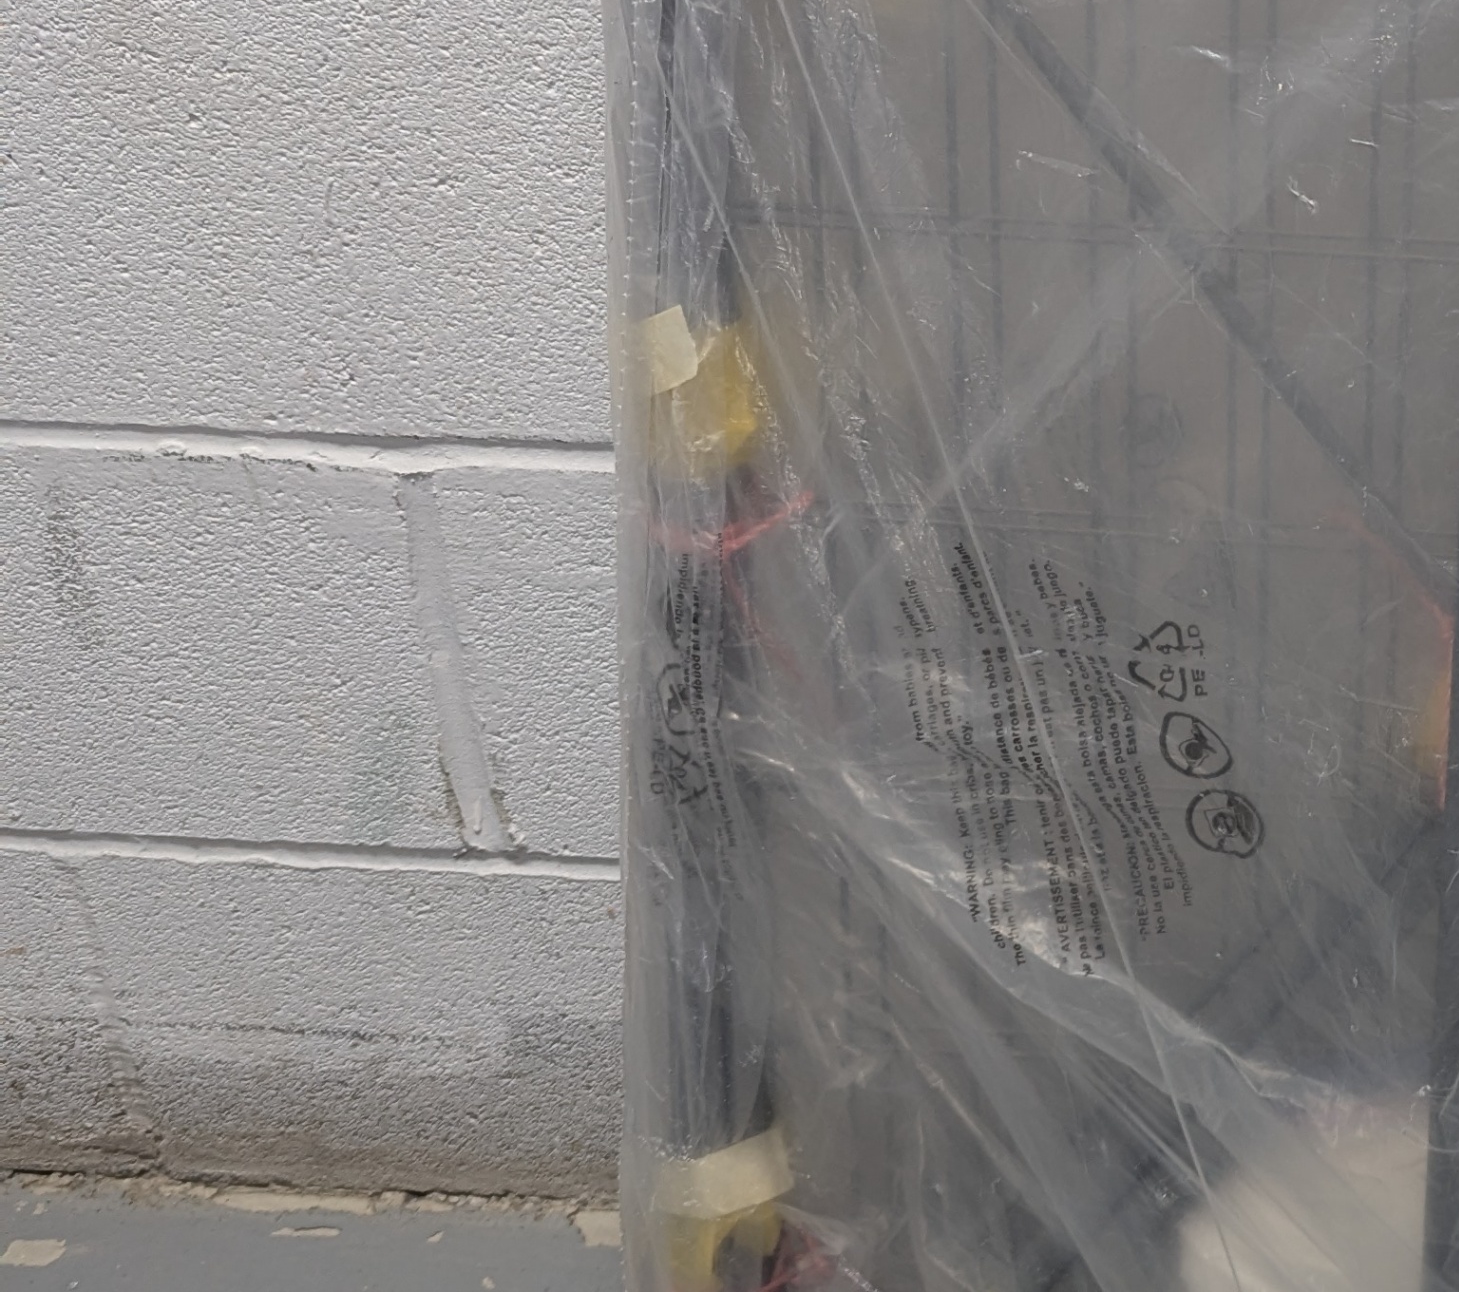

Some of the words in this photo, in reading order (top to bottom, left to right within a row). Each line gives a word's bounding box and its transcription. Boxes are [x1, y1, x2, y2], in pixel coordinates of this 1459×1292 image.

[973, 621, 985, 634] et
[1187, 624, 1208, 696] PE-LD
[921, 667, 930, 681] or
[931, 648, 951, 697] prevent
[1002, 666, 1013, 683] ou
[1035, 669, 1046, 686] un
[1083, 683, 1092, 692] o
[989, 692, 1000, 708] de
[1038, 690, 1054, 714] pas
[939, 700, 953, 725] and
[1006, 687, 1023, 752] carrosses
[912, 710, 925, 741] from
[993, 713, 1013, 764] distance
[1027, 735, 1038, 748] la
[1108, 722, 1125, 764] puede
[1124, 725, 1137, 755] Esta
[983, 772, 995, 804] nose
[998, 771, 1010, 795] bag
[955, 807, 970, 837] Keep
[988, 806, 999, 820] to
[1003, 798, 1016, 826] This
[1036, 799, 1051, 827] tenir
[963, 846, 980, 922] "WARNING:
[1044, 839, 1070, 952] AVERTISSEMENT
[1162, 877, 1175, 890] El
[1155, 915, 1166, 934] No
[1013, 943, 1026, 966] The
[1078, 935, 1090, 959] pas
